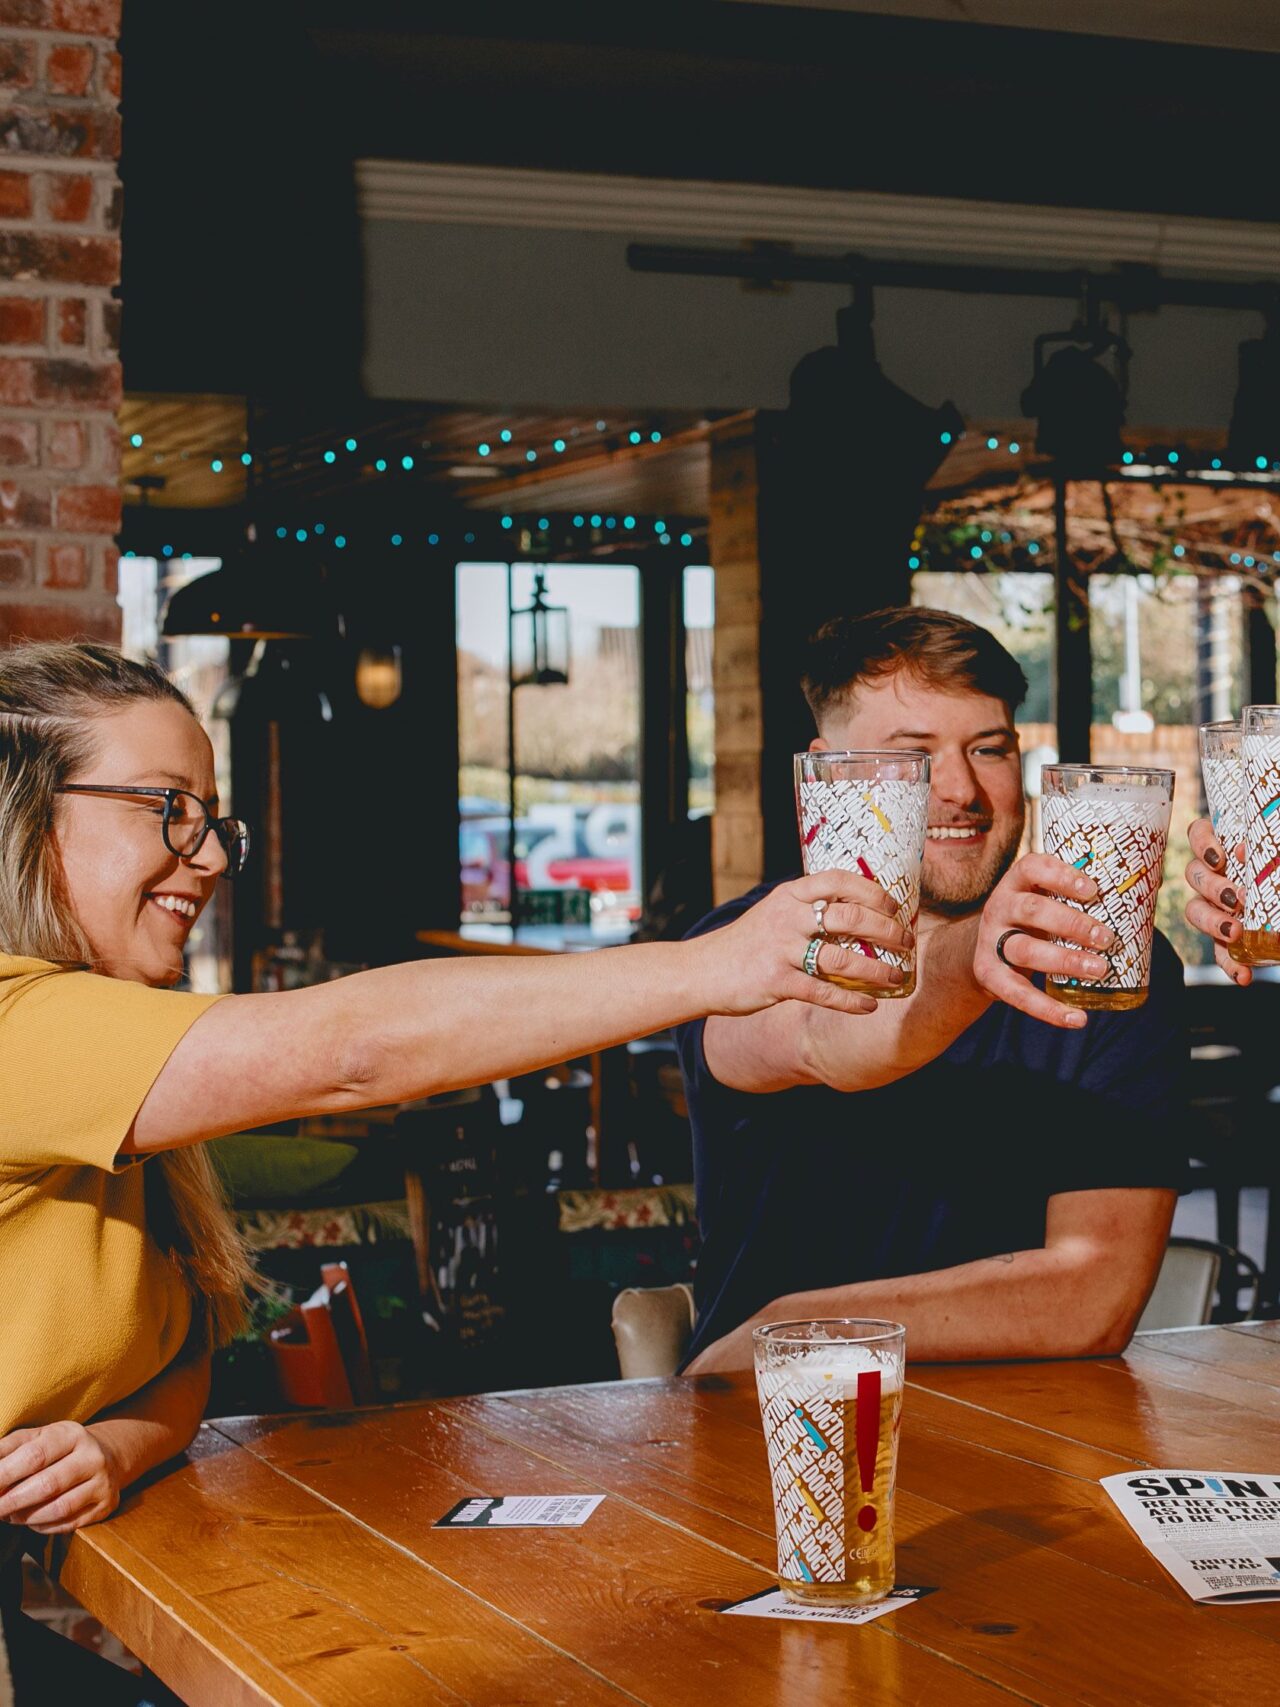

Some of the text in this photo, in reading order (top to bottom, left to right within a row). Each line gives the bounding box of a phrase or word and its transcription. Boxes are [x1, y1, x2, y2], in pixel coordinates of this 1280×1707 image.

[1141, 1499, 1218, 1509] RELIEF
[1225, 1499, 1249, 1509] IN
[1149, 1507, 1177, 1517] AS
[1185, 1507, 1230, 1516] UFO
[1151, 1515, 1184, 1525] TO
[1189, 1515, 1221, 1523] BE
[1190, 1557, 1254, 1565] TRUTH
[1228, 1562, 1262, 1570] TAP
